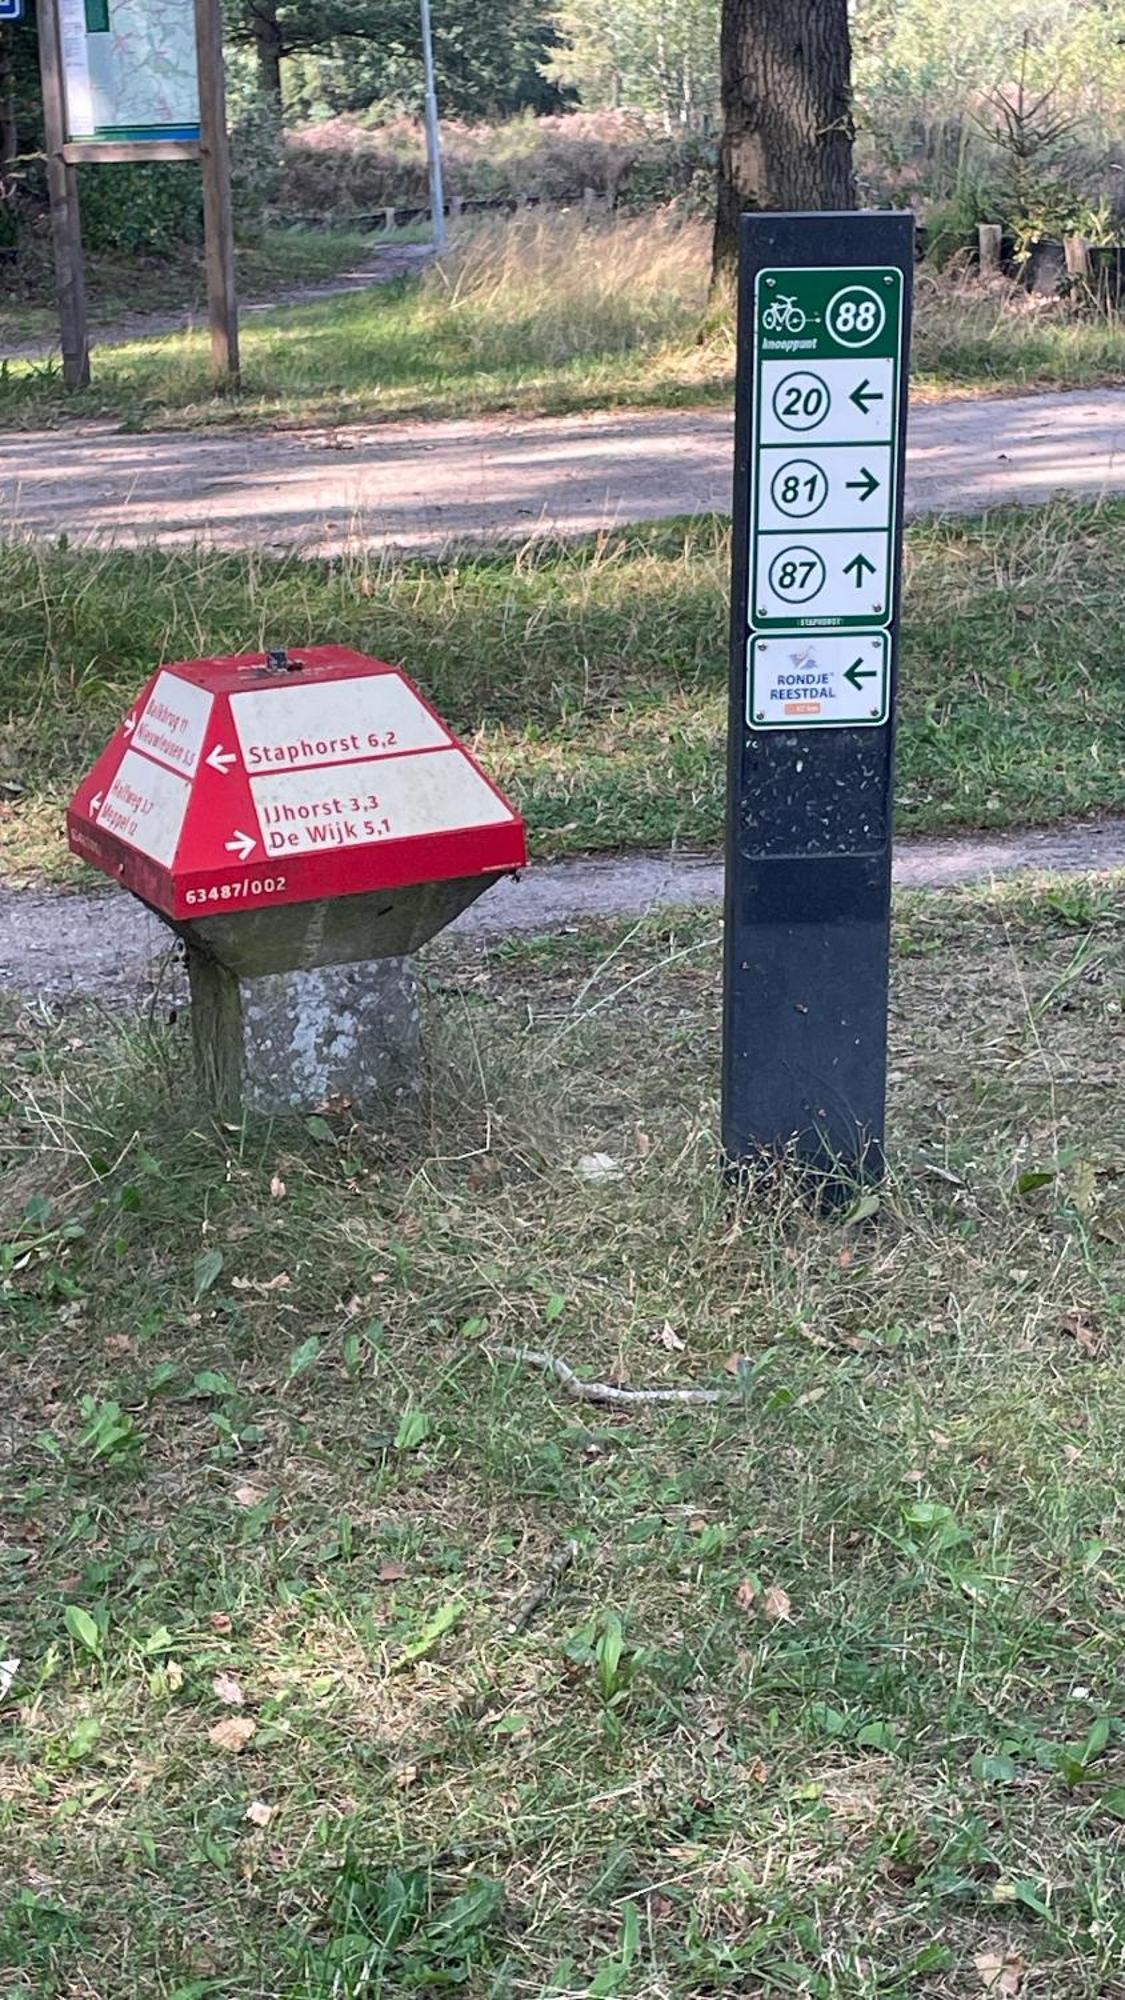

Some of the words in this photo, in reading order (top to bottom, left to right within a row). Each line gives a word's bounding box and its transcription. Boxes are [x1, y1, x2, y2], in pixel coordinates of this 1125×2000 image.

[836, 301, 876, 333] 88
[761, 337, 818, 353] knooppunt
[782, 387, 823, 417] 20
[781, 474, 818, 504] 81
[778, 561, 818, 590] 87
[769, 687, 836, 701] REESTDAL
[777, 673, 829, 686] RONDJE
[146, 698, 181, 733] Balkbrug
[248, 734, 361, 765] Staphorst
[367, 730, 398, 749] 6,2
[100, 801, 131, 833] Meppel
[263, 797, 343, 824] IJhorst
[349, 794, 380, 813] 3,3
[269, 830, 300, 850] De
[305, 821, 358, 845] Wijk
[363, 817, 392, 837] 5,1
[184, 875, 287, 905] 63487/002
